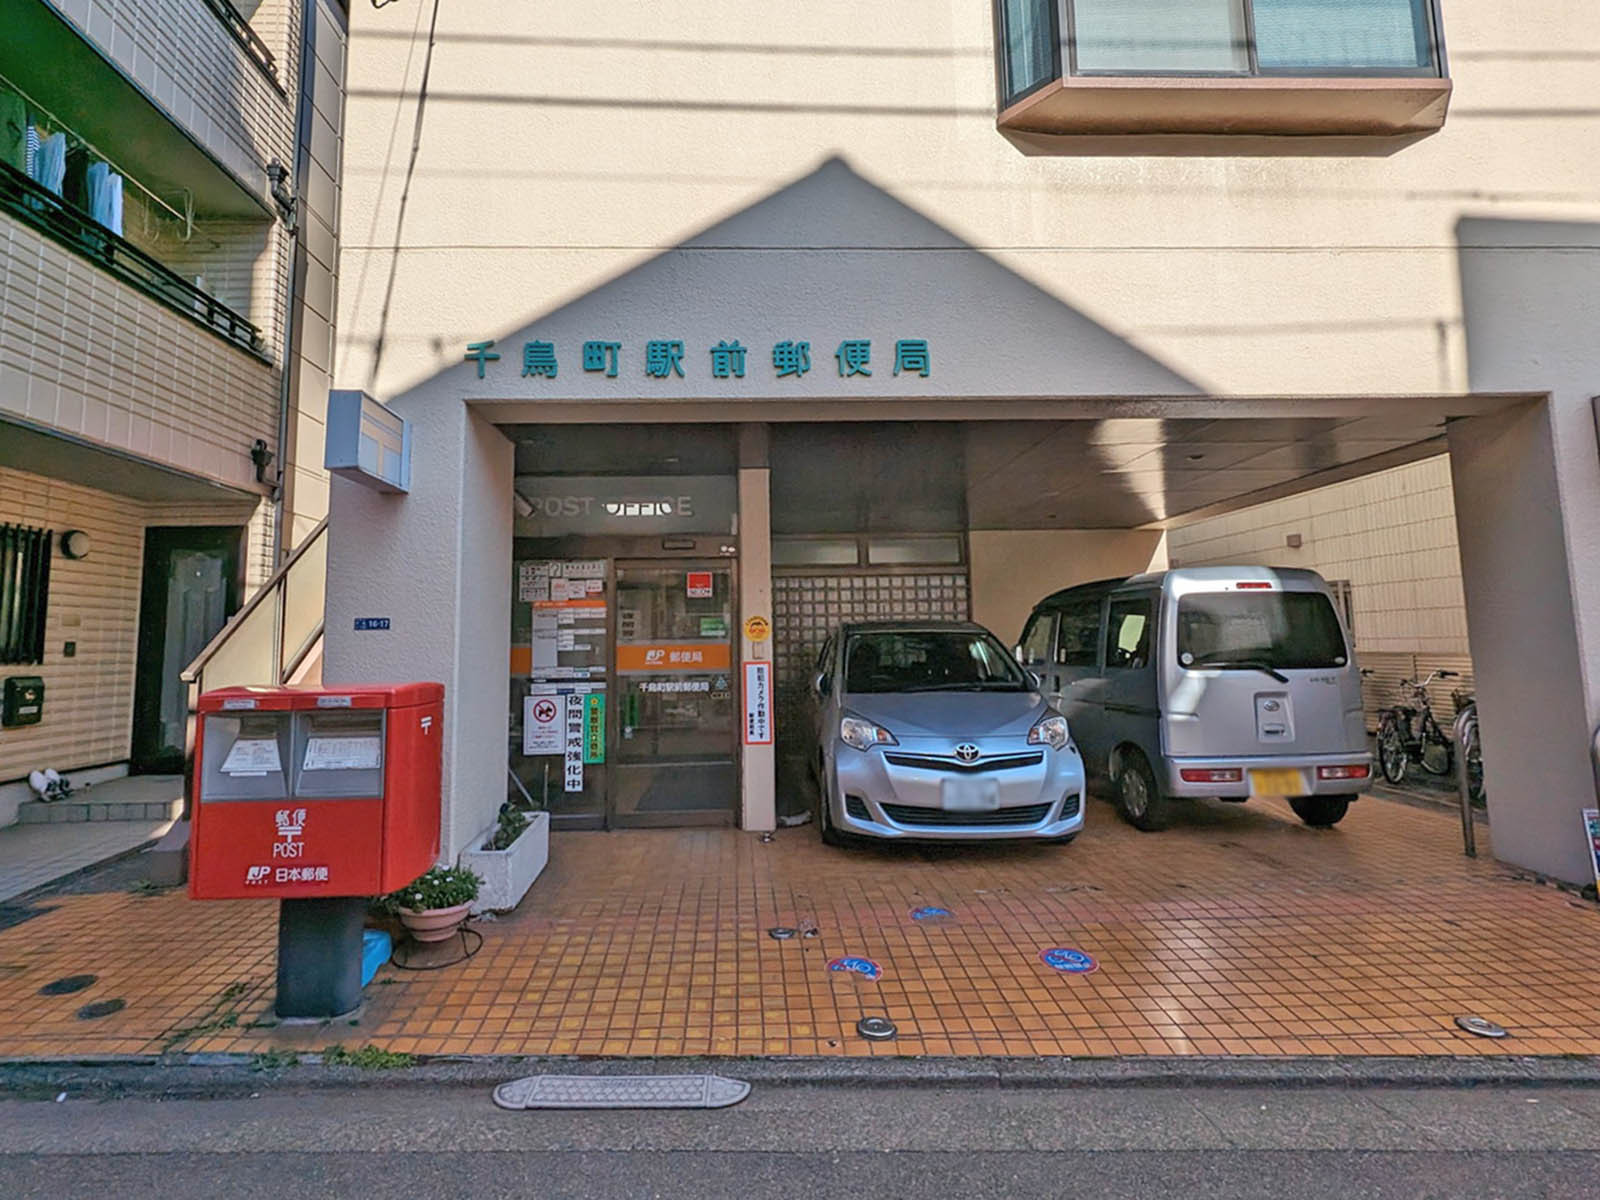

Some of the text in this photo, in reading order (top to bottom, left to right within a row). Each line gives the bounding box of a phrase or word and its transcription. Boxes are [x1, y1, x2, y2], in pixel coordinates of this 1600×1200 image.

[464, 340, 931, 379] 千鳥町駅前郵便局
[565, 695, 583, 790] 夜間警戒強化中
[275, 808, 307, 827] 郵便
[273, 842, 305, 858] POST
[275, 867, 329, 882] 日本郵便
